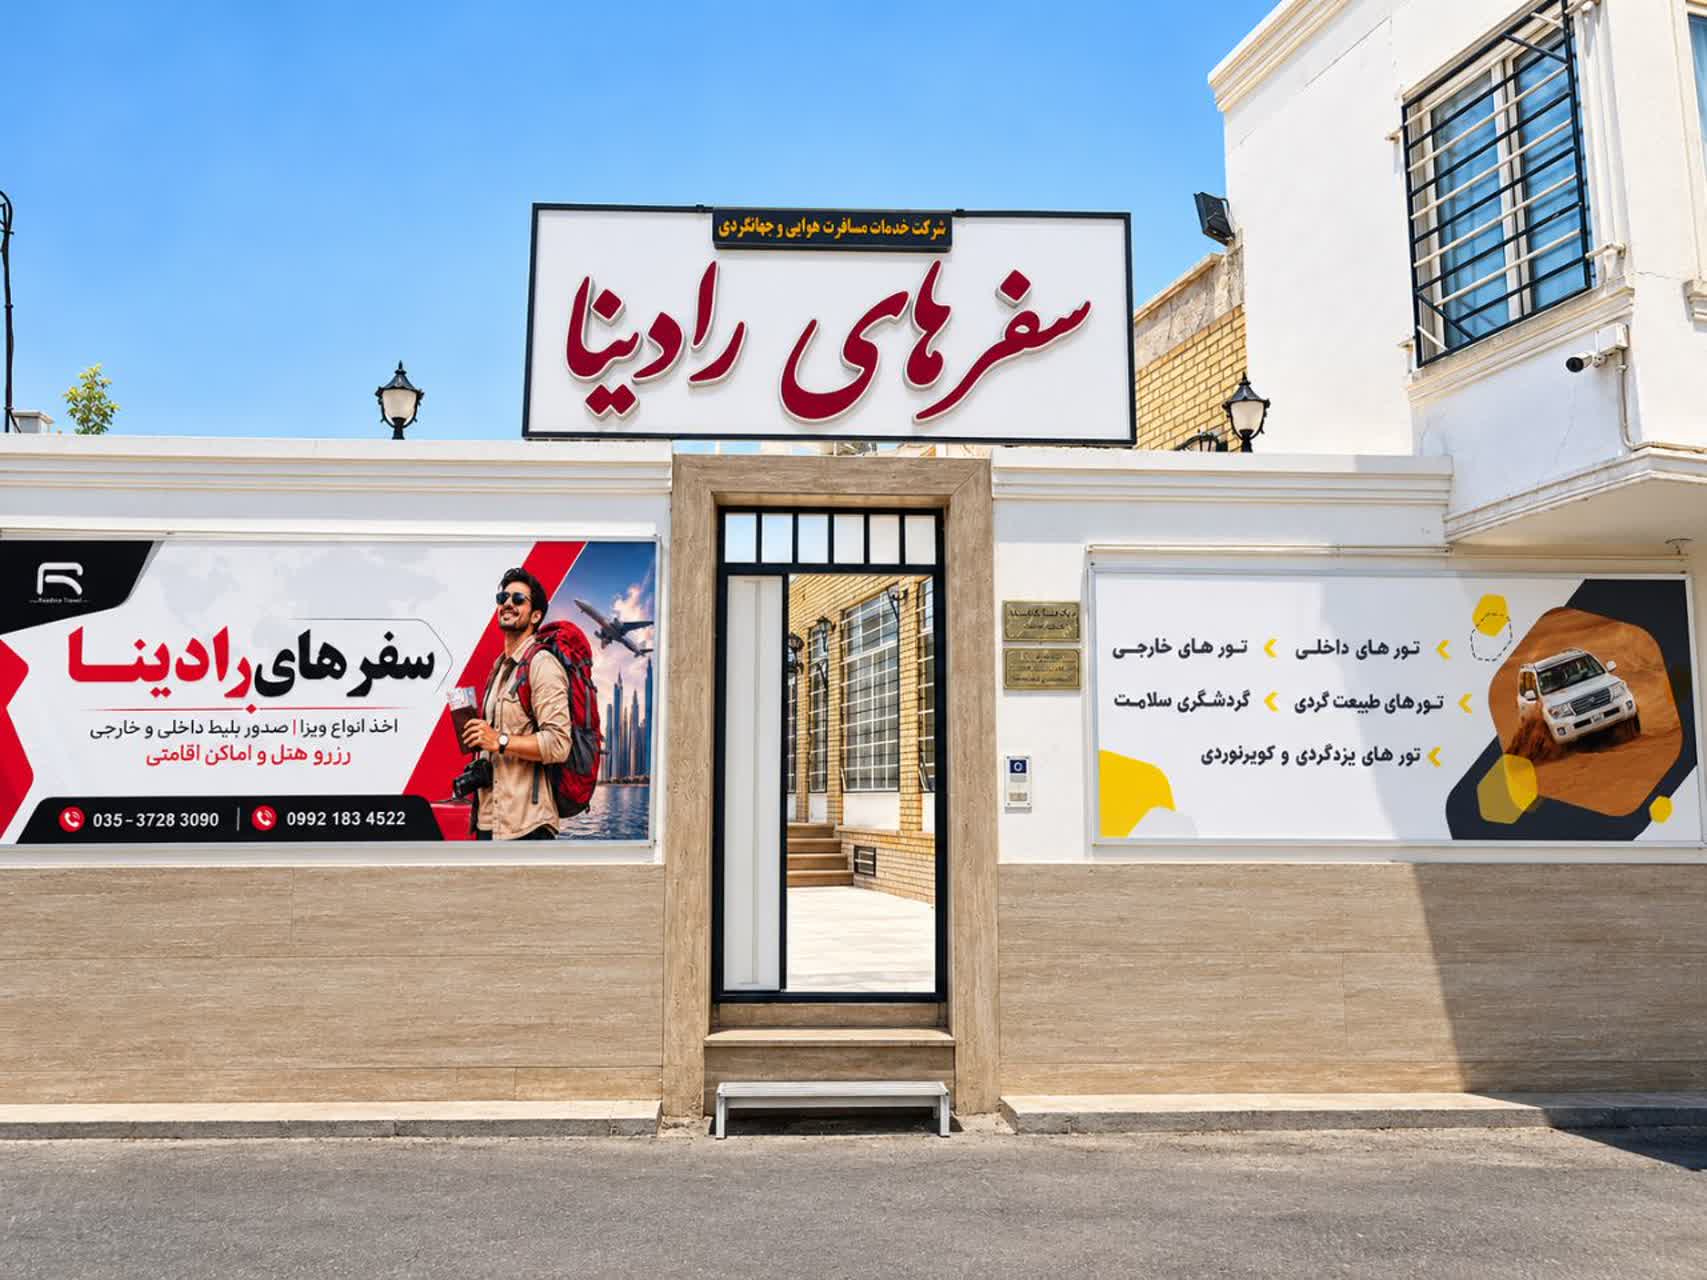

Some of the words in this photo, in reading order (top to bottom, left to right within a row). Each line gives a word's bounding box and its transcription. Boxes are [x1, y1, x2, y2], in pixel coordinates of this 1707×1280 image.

[718, 216, 774, 238] جهانگردی
[777, 223, 784, 238] و
[785, 217, 820, 239] هوایی
[823, 217, 868, 239] مسافرت
[869, 218, 910, 235] خدمات
[911, 218, 946, 241] شرکت
[565, 261, 746, 416] رادینا
[1112, 637, 1173, 660] خارجی
[1295, 638, 1350, 661] داخلی
[68, 625, 252, 699] رادینا
[1113, 690, 1173, 710] سلامت
[1177, 689, 1251, 713] گردشگری
[1294, 690, 1330, 714] گردی
[1332, 693, 1381, 715] طبیعت
[89, 719, 141, 741] خارجی
[144, 725, 154, 740] و
[157, 719, 204, 740] داخلی
[208, 718, 241, 739] بلیط
[244, 722, 289, 739] صدور
[301, 718, 327, 738] ویزا
[331, 718, 365, 739] انواع
[369, 718, 398, 733] اخذ
[145, 744, 201, 767] اقامتی
[204, 745, 253, 767] اماکن
[256, 751, 268, 767] و
[270, 745, 309, 767] هتل
[313, 745, 352, 768] رزرو
[1200, 744, 1277, 767] کویرنوردی
[1281, 750, 1290, 767] و
[1295, 743, 1356, 768] یزدگردی
[179, 812, 219, 827] 3090
[286, 811, 327, 826] 0992
[333, 811, 361, 826] 183
[366, 811, 406, 826] 4522
